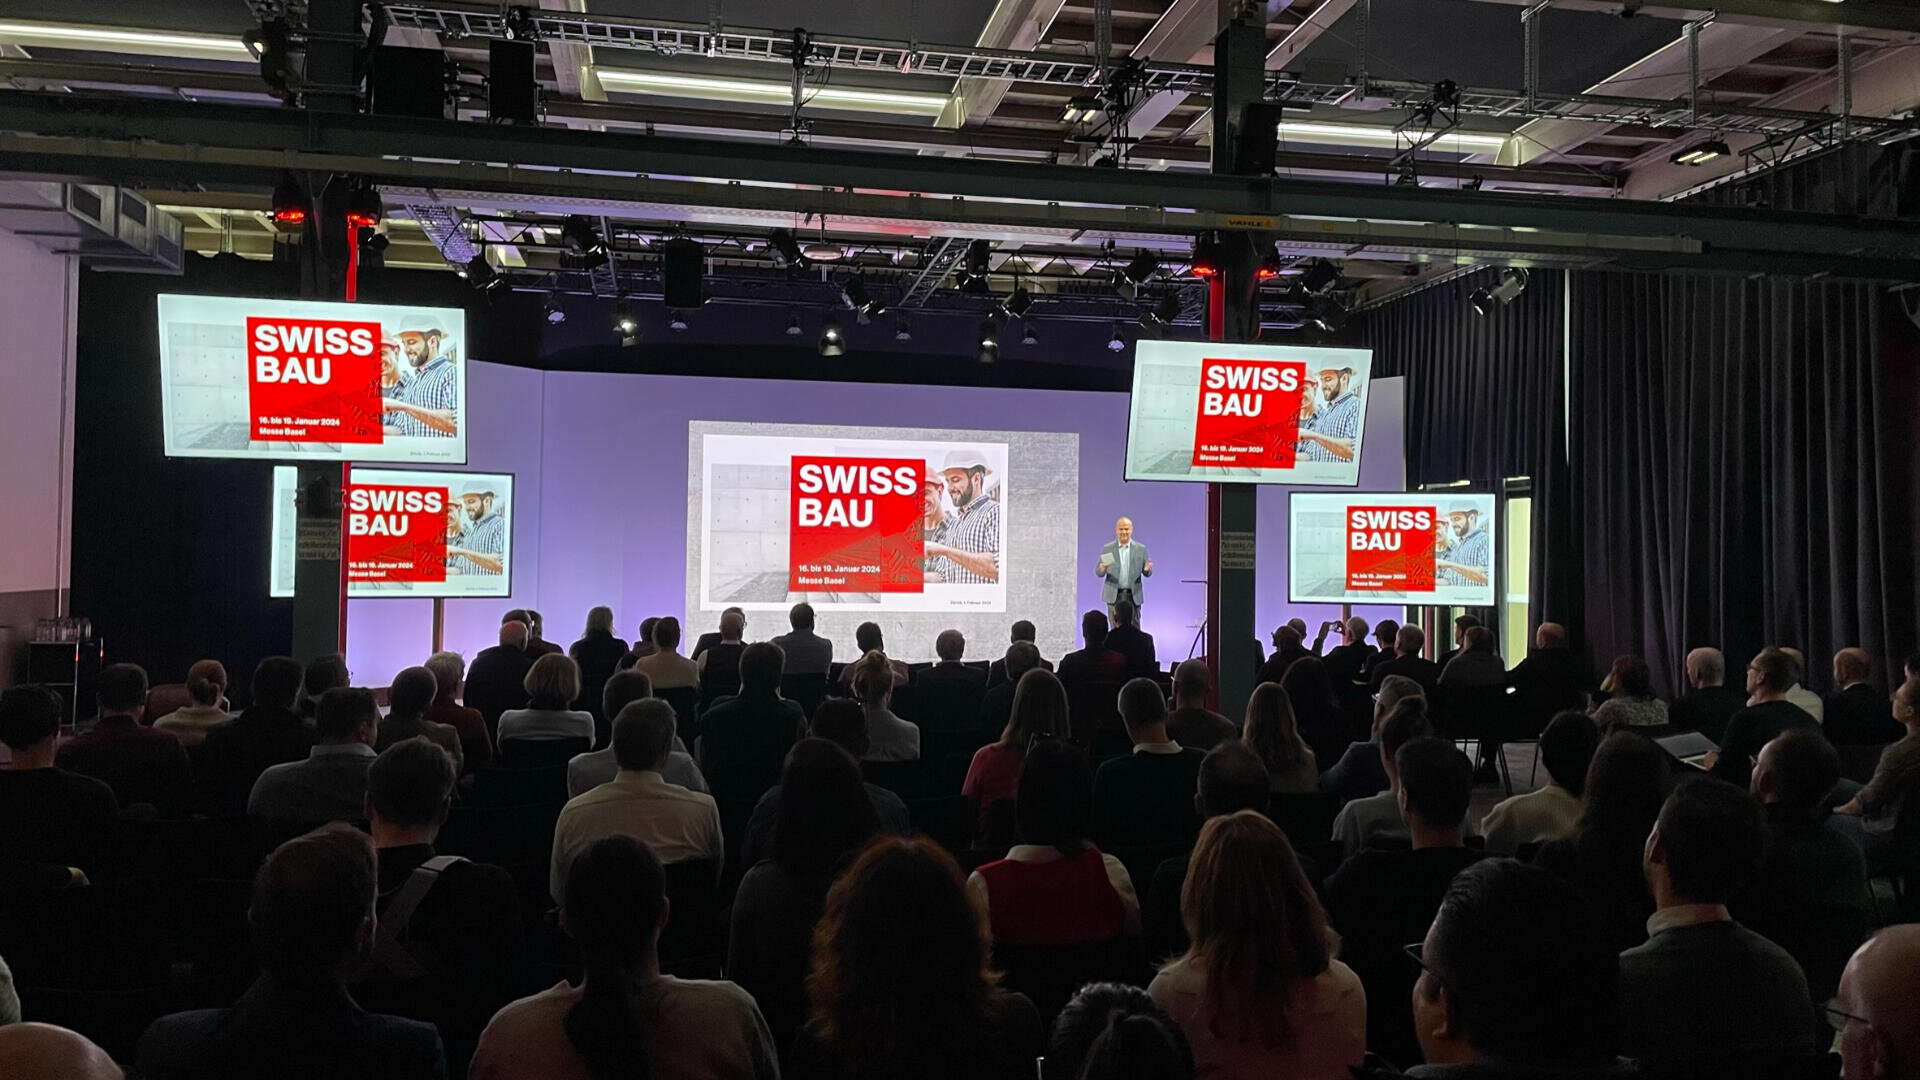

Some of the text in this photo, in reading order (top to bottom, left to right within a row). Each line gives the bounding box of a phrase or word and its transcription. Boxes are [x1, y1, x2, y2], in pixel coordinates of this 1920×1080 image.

[254, 324, 374, 356] SWISS
[255, 355, 331, 385] BAU
[1206, 365, 1298, 392] SWISS
[1203, 391, 1263, 417] BAU
[259, 416, 340, 427] 16. bis 19. Januar 2024
[259, 427, 306, 436] Messe Basel
[1228, 445, 1248, 453] Januar
[799, 464, 917, 496] SWISS
[350, 489, 443, 514] SWISS
[798, 498, 873, 528] BAU
[1351, 510, 1431, 531] SWISS
[350, 513, 409, 537] BAU
[1351, 532, 1402, 551] BAU
[348, 570, 387, 578] Messe Basel
[398, 562, 414, 570] 2024
[799, 564, 880, 574] 16. bis 19. Januar 2024
[798, 576, 845, 585] Messe Basel
